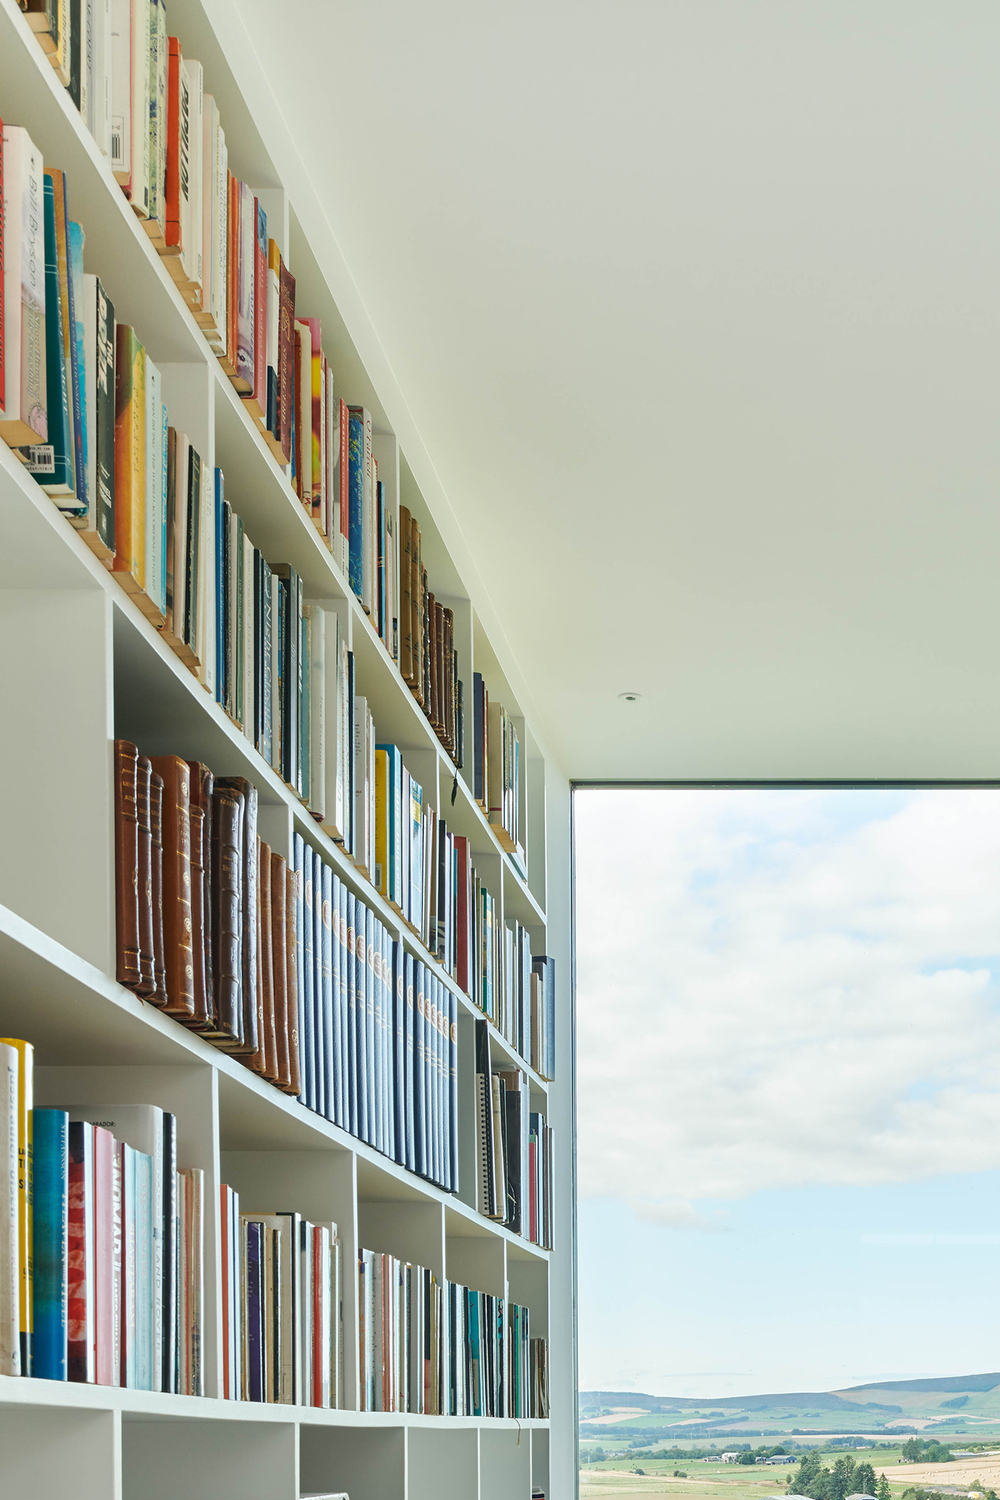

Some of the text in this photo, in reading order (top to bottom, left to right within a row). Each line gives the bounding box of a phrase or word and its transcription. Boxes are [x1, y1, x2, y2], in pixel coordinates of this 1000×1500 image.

[181, 80, 190, 202] PAPILLON
[29, 175, 39, 288] Bill Bryson
